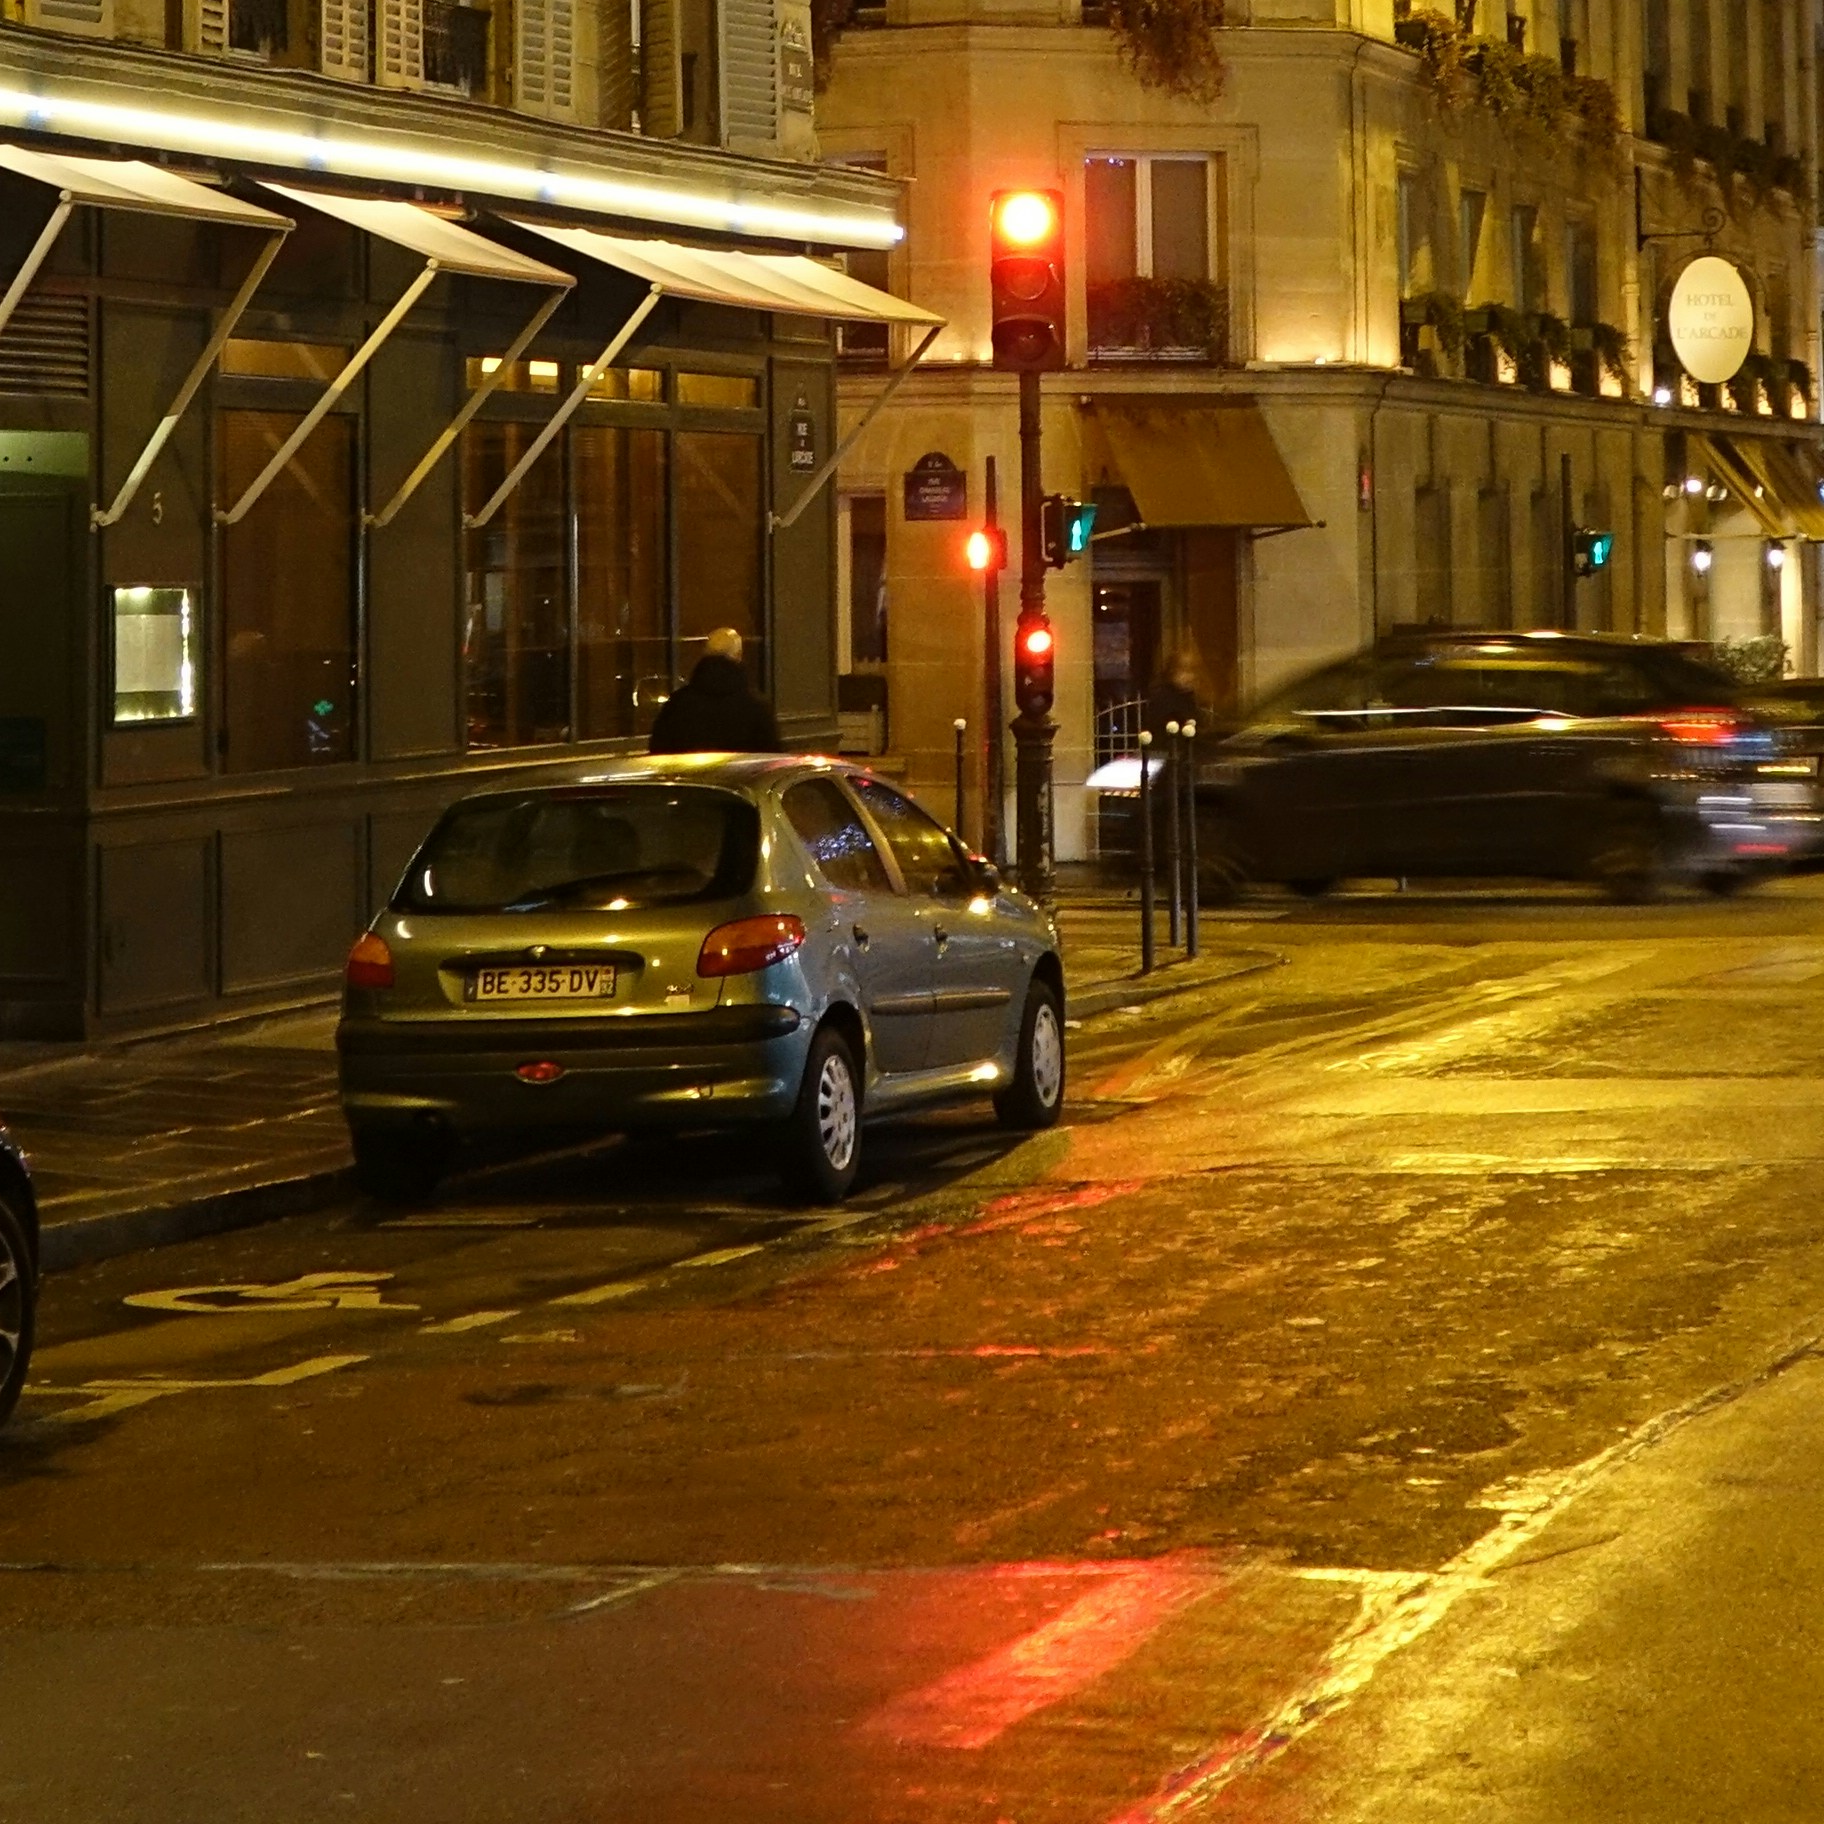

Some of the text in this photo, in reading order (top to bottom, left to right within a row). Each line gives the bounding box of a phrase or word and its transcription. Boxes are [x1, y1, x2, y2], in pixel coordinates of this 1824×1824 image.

[1686, 294, 1735, 307] HOTEL
[1677, 326, 1749, 339] L'ARCADE
[482, 969, 599, 995] BE-335-DV
